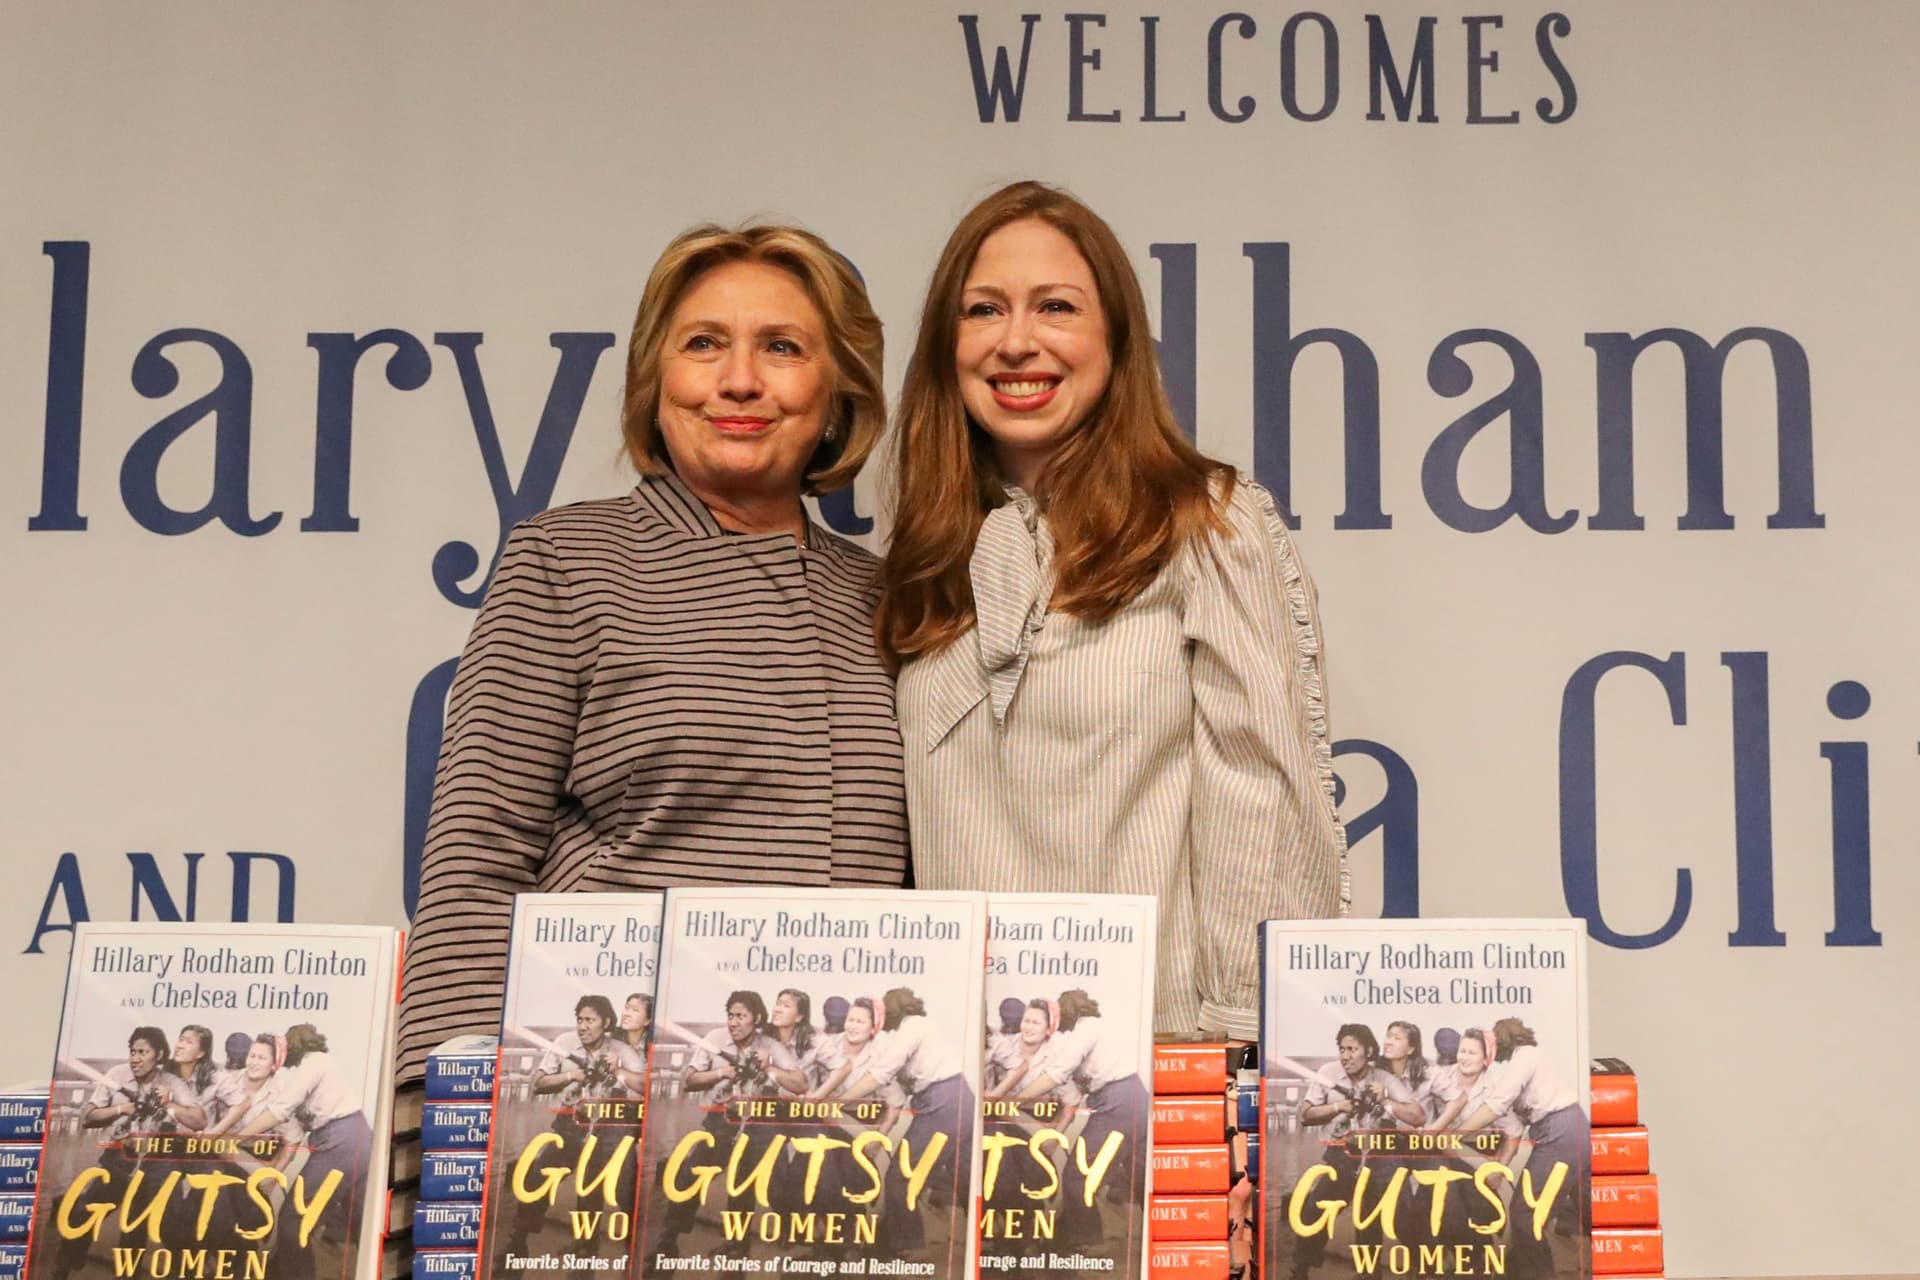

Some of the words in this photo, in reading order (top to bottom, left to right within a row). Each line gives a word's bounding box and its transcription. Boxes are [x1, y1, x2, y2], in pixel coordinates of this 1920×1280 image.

[957, 11, 1577, 125] WELCOMES
[22, 852, 295, 954] AND
[1558, 650, 1920, 950] Cli
[535, 917, 616, 948] Hillary
[685, 911, 766, 942] Hillary
[776, 911, 869, 938] Rodham
[879, 913, 961, 940] Clinton
[1053, 916, 1133, 943] Clinton
[92, 947, 174, 978] Hillary
[182, 947, 274, 974] Rodham
[284, 948, 367, 976] Clinton
[565, 967, 589, 977] AND
[716, 962, 740, 972] AND
[746, 946, 833, 973] Chelsea
[842, 947, 925, 974] Clinton
[1018, 950, 1099, 976] Clinton
[1289, 944, 1370, 975] Hillary
[1380, 943, 1474, 969] Rodham
[1483, 943, 1566, 969] Clinton
[120, 998, 145, 1008] AND
[151, 982, 238, 1009] Chelsea
[247, 983, 329, 1010] Clinton
[1322, 995, 1347, 1005] AND
[1353, 978, 1441, 1005] Chelsea
[1450, 978, 1533, 1005] Clinton
[438, 1062, 480, 1077] Hillary
[0, 1102, 43, 1119] Hillary
[434, 1112, 476, 1127] Hillary
[584, 1103, 626, 1119] THE
[736, 1101, 777, 1117] THE
[789, 1101, 844, 1118] BOOK
[857, 1103, 883, 1119] OF
[1033, 1102, 1059, 1117] OF
[133, 1137, 174, 1153] THE
[186, 1138, 240, 1155] BOOK
[253, 1139, 279, 1155] OF
[1354, 1134, 1396, 1150] THE
[1409, 1134, 1464, 1150] BOOK
[1476, 1134, 1501, 1150] OF
[434, 1161, 476, 1178] Hillary
[662, 1130, 948, 1211] GUTSY
[56, 1167, 344, 1248] GUTSY
[1288, 1161, 1569, 1241] GUTSY
[426, 1209, 468, 1225] Hillary
[720, 1210, 878, 1244] WOMEN
[112, 1247, 270, 1280] WOMEN
[425, 1258, 468, 1275] Hillary
[505, 1252, 559, 1270] Favorite
[562, 1253, 610, 1270] Stories
[613, 1255, 629, 1271] of
[655, 1253, 710, 1271] Favorite
[713, 1254, 761, 1272] Stories
[764, 1255, 781, 1273] of
[782, 1256, 836, 1278] Courage
[839, 1258, 866, 1275] and
[869, 1258, 935, 1276] Resilience
[1020, 1253, 1046, 1269] and
[1049, 1253, 1114, 1271] Resilience
[1350, 1244, 1507, 1275] WOMEN
